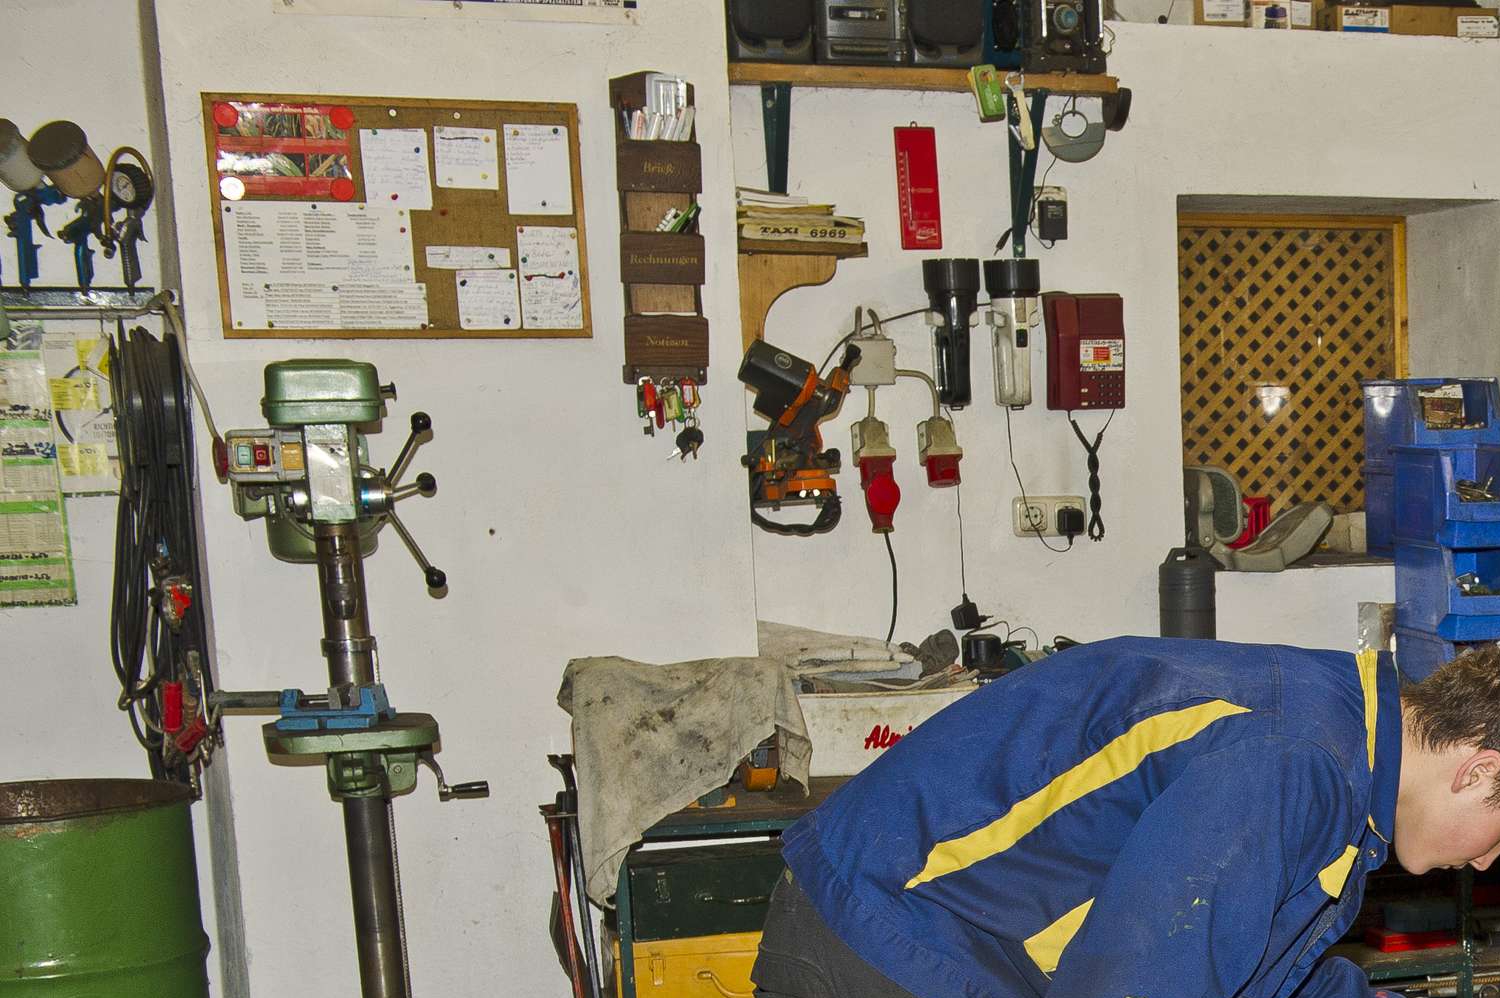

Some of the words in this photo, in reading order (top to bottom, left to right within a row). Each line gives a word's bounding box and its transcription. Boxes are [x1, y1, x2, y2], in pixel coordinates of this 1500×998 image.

[760, 226, 799, 234] TAXI
[809, 228, 847, 239] 6969
[630, 253, 698, 265] Rechnungen
[645, 335, 689, 347] Notizen
